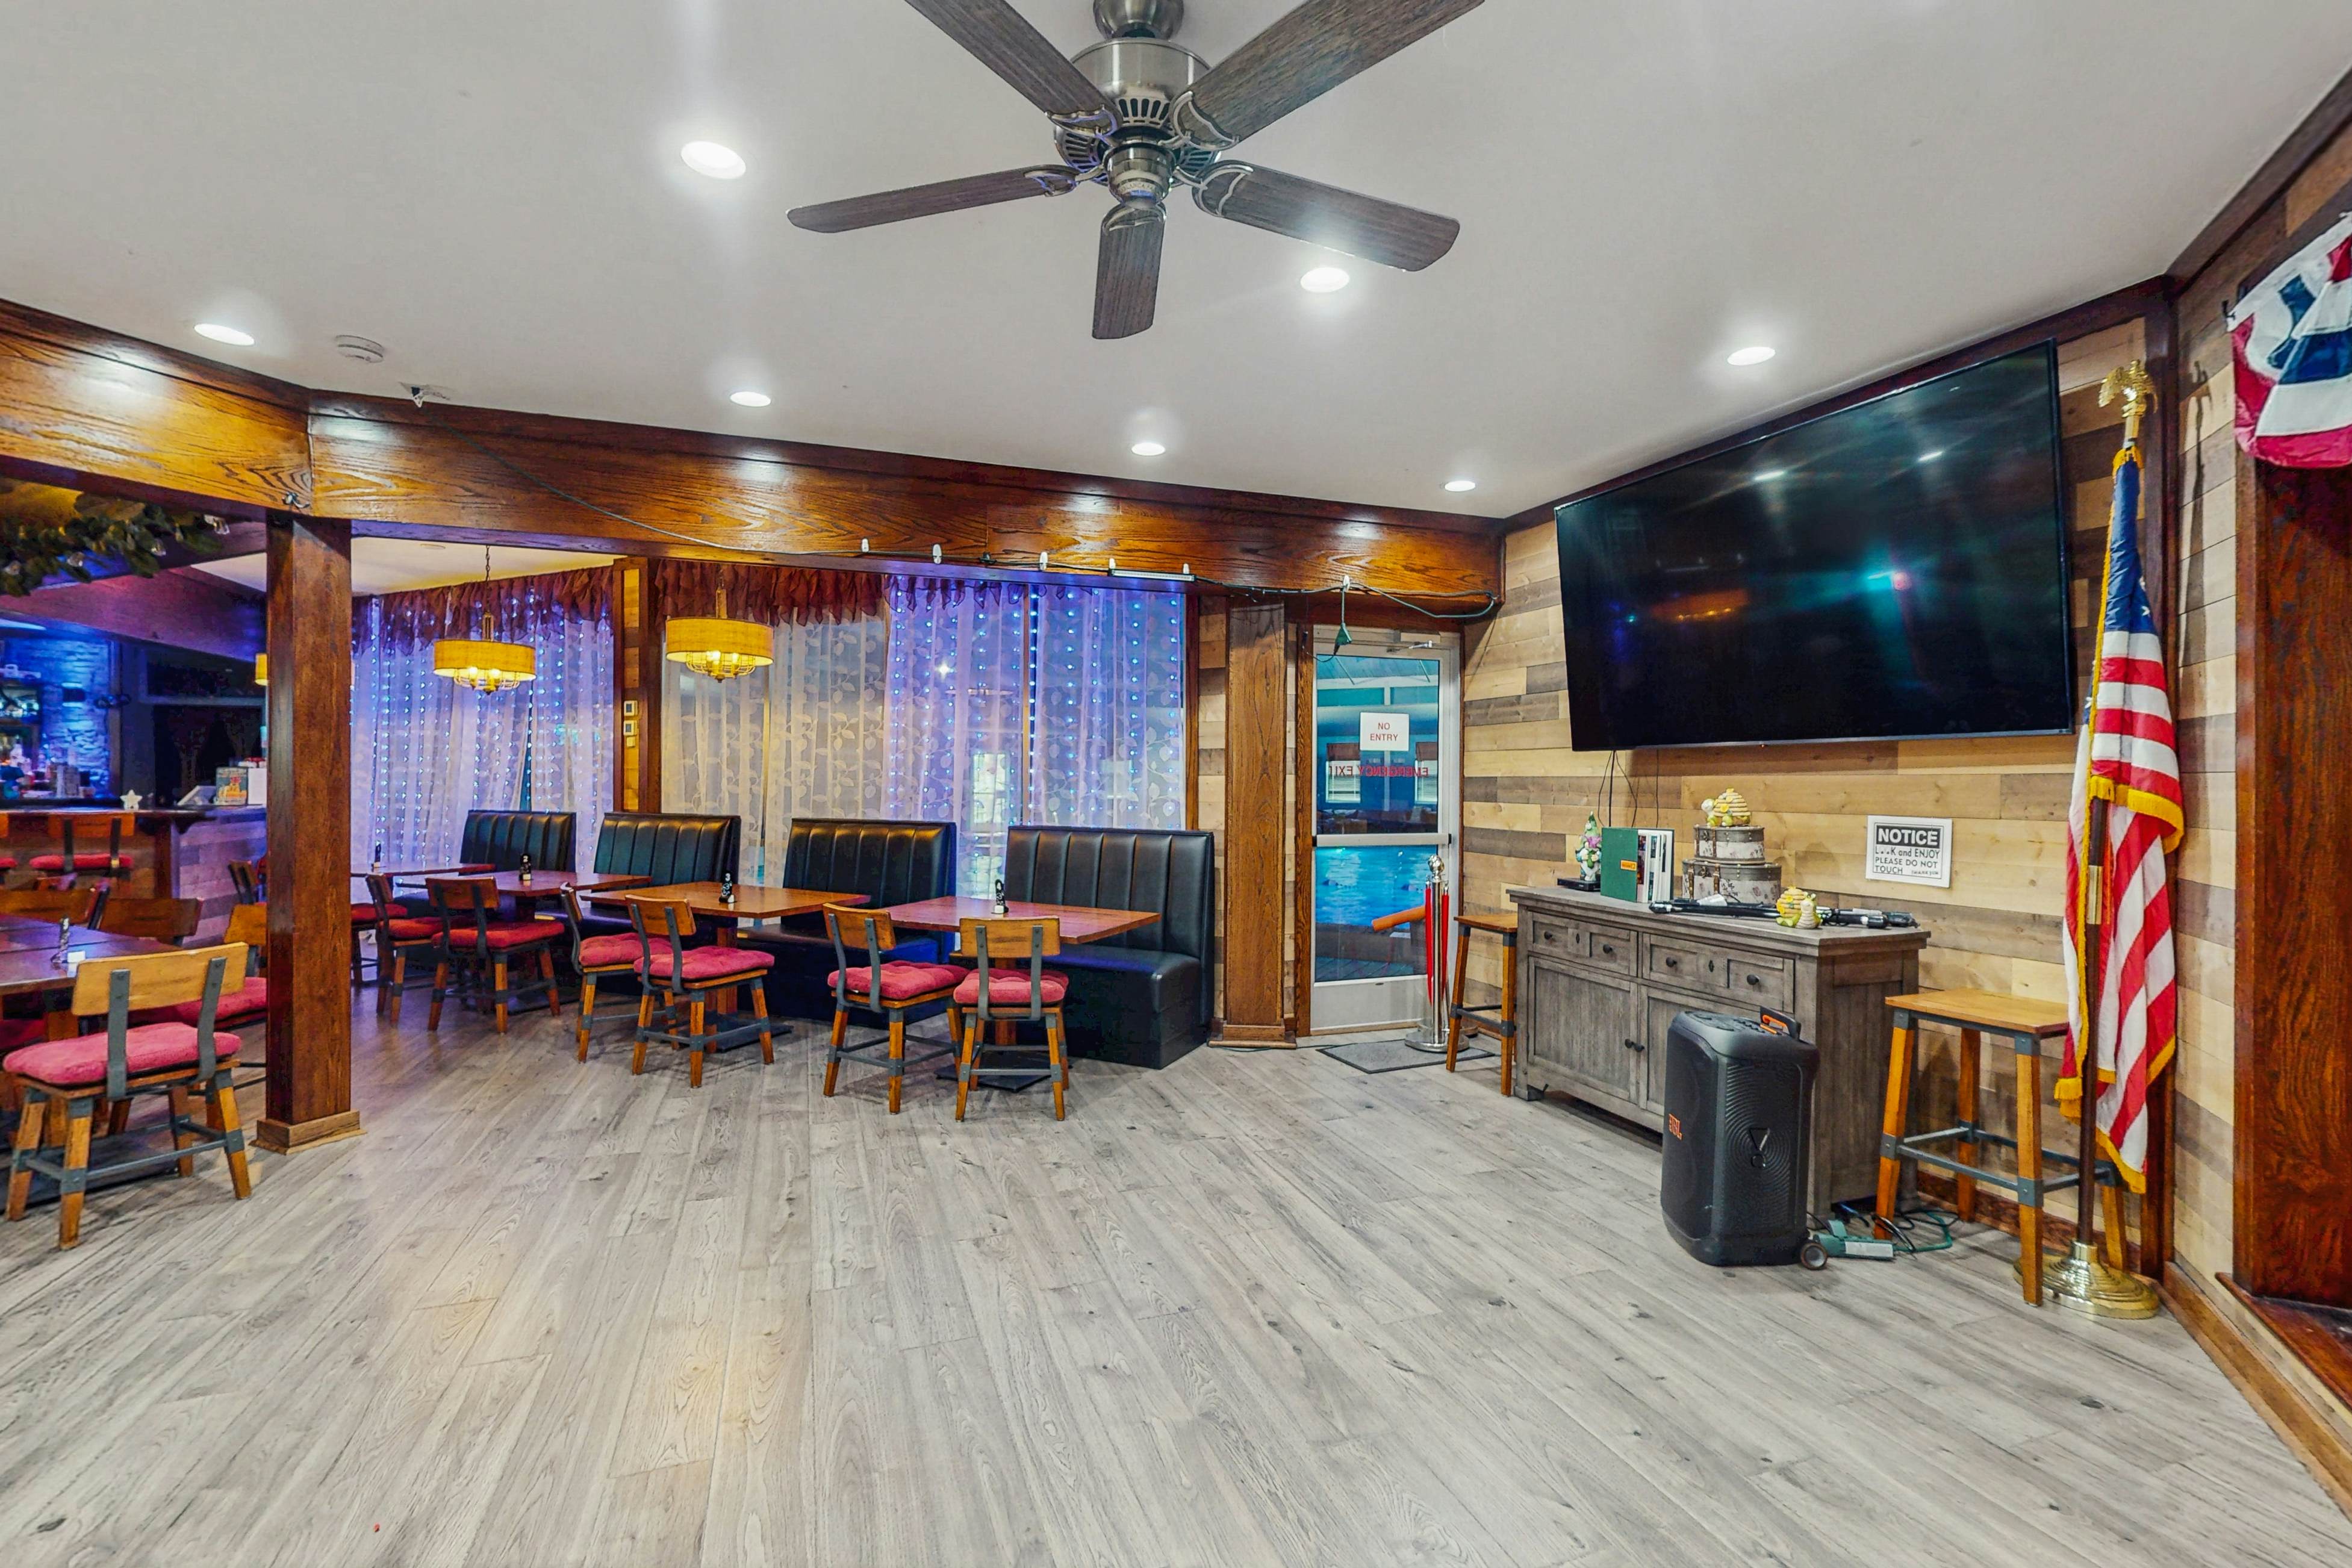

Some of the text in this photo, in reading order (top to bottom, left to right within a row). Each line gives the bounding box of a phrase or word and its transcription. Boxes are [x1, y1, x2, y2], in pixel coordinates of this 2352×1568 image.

[1878, 828, 1938, 846] NOTICE
[1875, 845, 1940, 859] LK and ENJOY
[1875, 857, 1903, 865] PLEASE
[1875, 865, 1903, 874] TOUCH
[725, 873, 730, 882] 3
